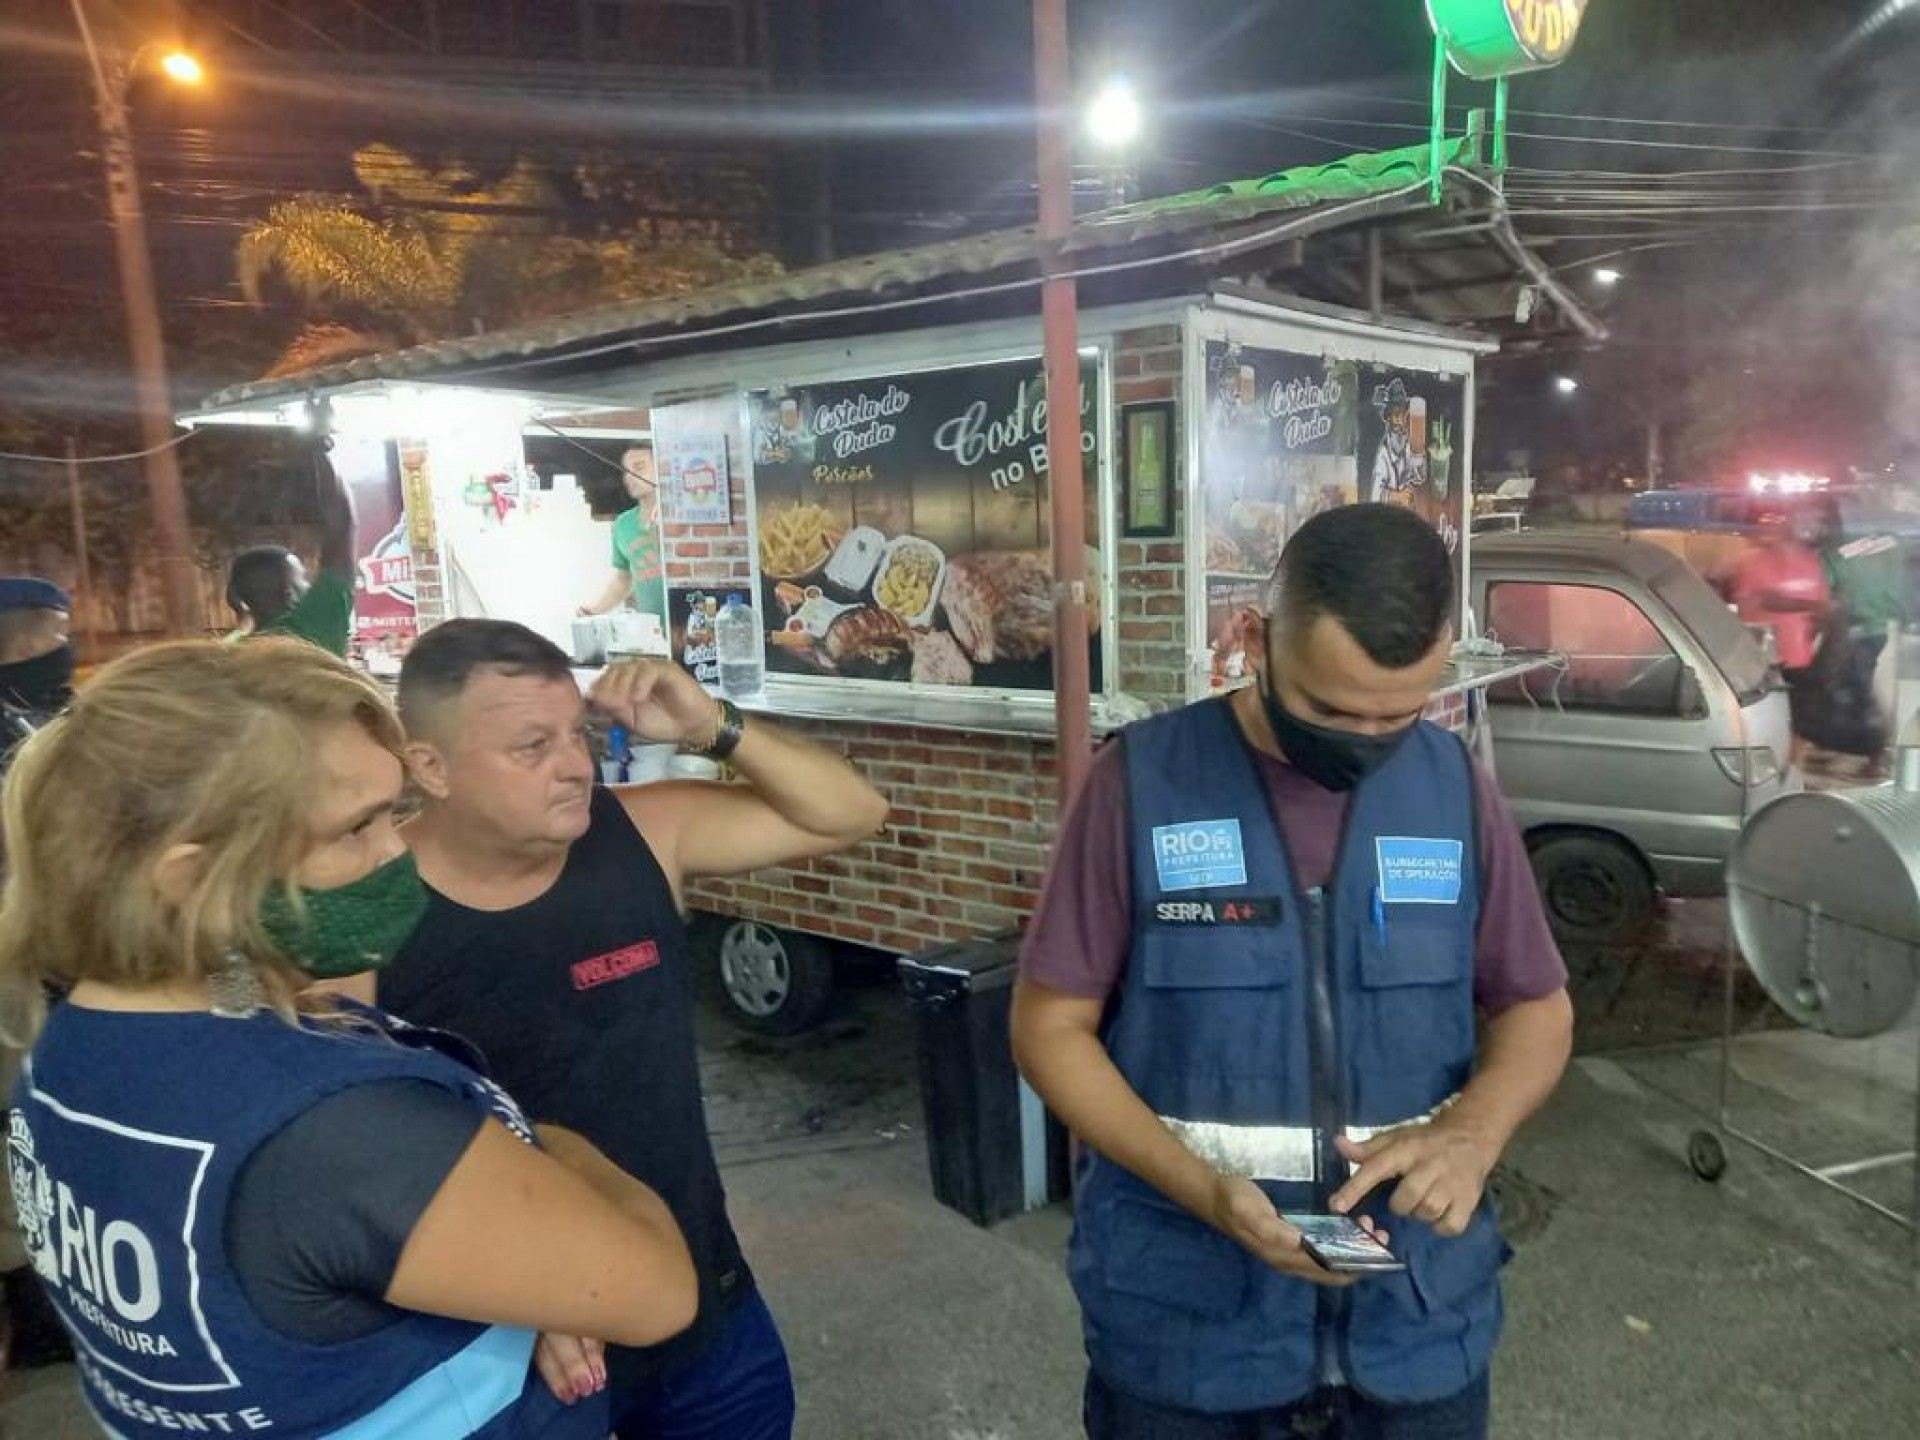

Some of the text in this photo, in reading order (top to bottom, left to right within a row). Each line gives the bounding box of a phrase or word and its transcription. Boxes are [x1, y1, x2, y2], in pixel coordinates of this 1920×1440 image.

[991, 431, 1095, 491] no Bo
[1162, 829, 1210, 856] RIO
[1156, 900, 1256, 922] SERPA A+
[57, 1180, 161, 1322] RIO
